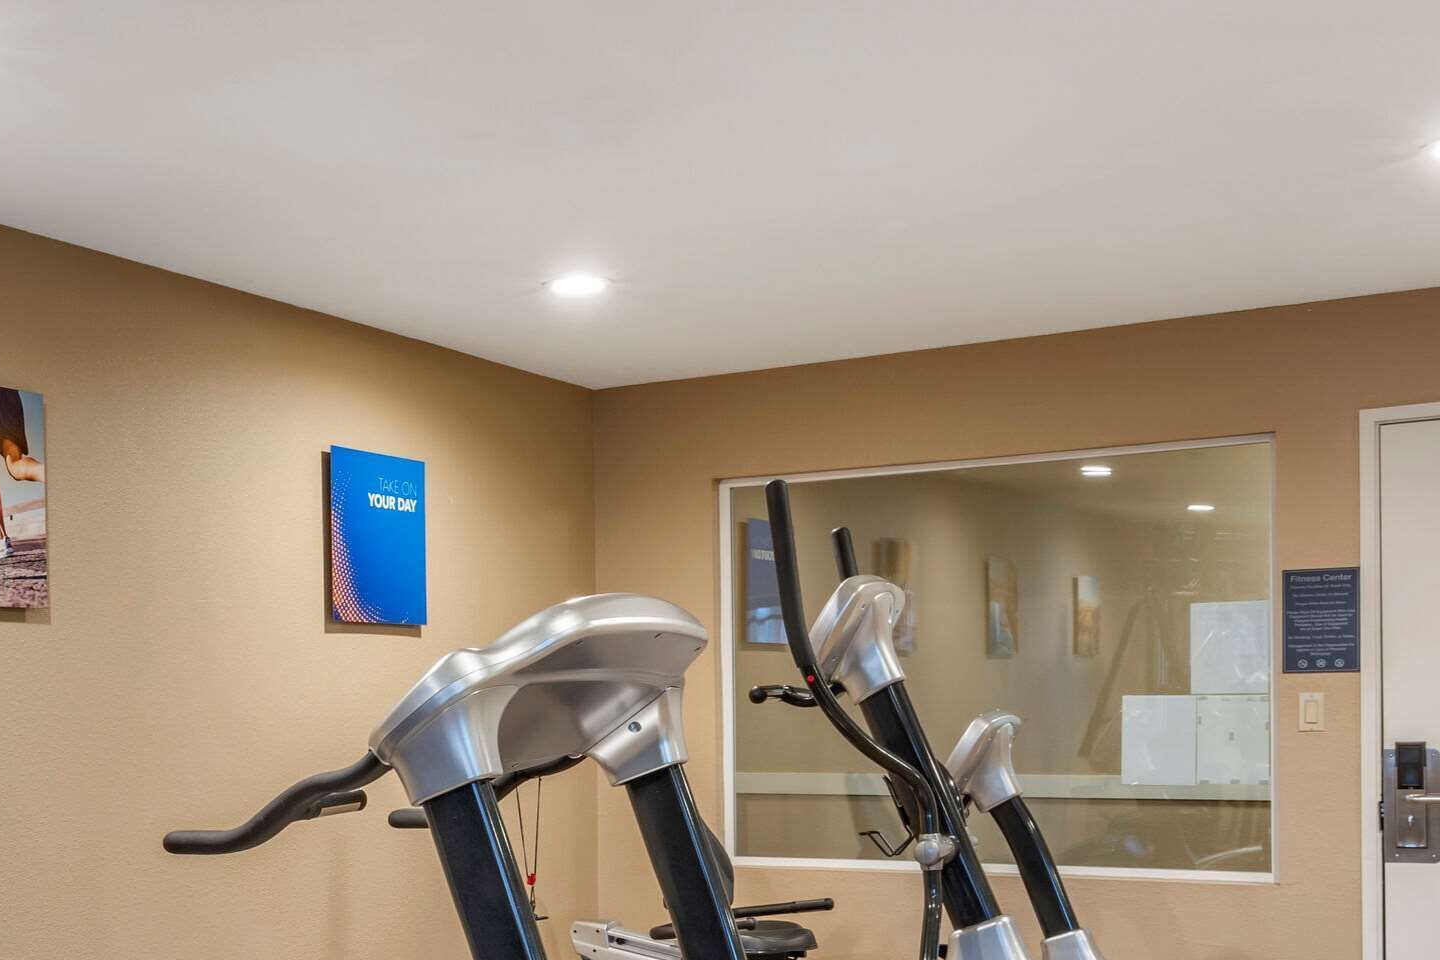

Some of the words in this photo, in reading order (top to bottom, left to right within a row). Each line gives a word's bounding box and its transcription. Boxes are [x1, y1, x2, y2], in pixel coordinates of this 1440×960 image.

[378, 477, 399, 494] TAKE
[402, 481, 417, 497] ON
[368, 492, 396, 510] YOUR
[397, 497, 417, 512] DAY
[1290, 575, 1321, 583] Fitness
[1322, 573, 1353, 582] Center
